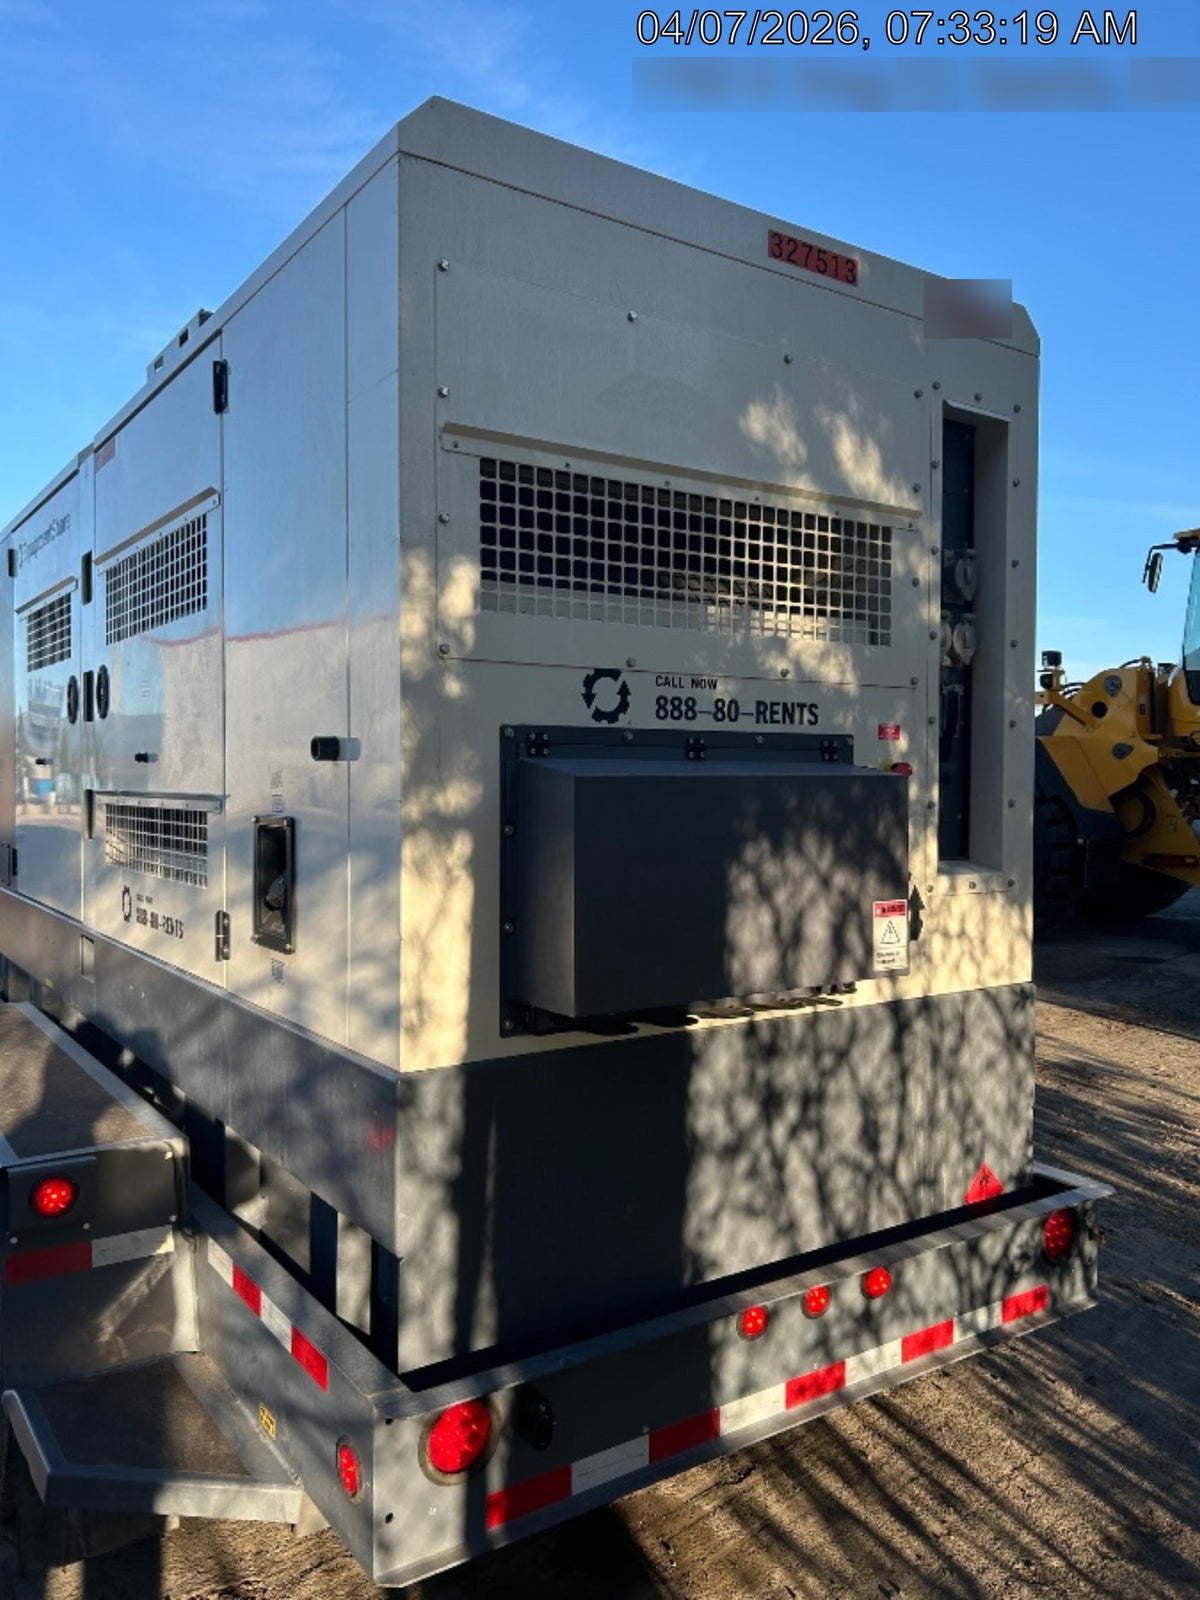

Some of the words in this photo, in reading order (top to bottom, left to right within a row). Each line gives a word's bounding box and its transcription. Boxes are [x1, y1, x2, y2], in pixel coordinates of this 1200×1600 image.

[770, 231, 857, 284] 327513
[655, 675, 685, 689] CALL
[691, 677, 718, 690] NOW
[655, 695, 819, 726] 888-80-RENTS
